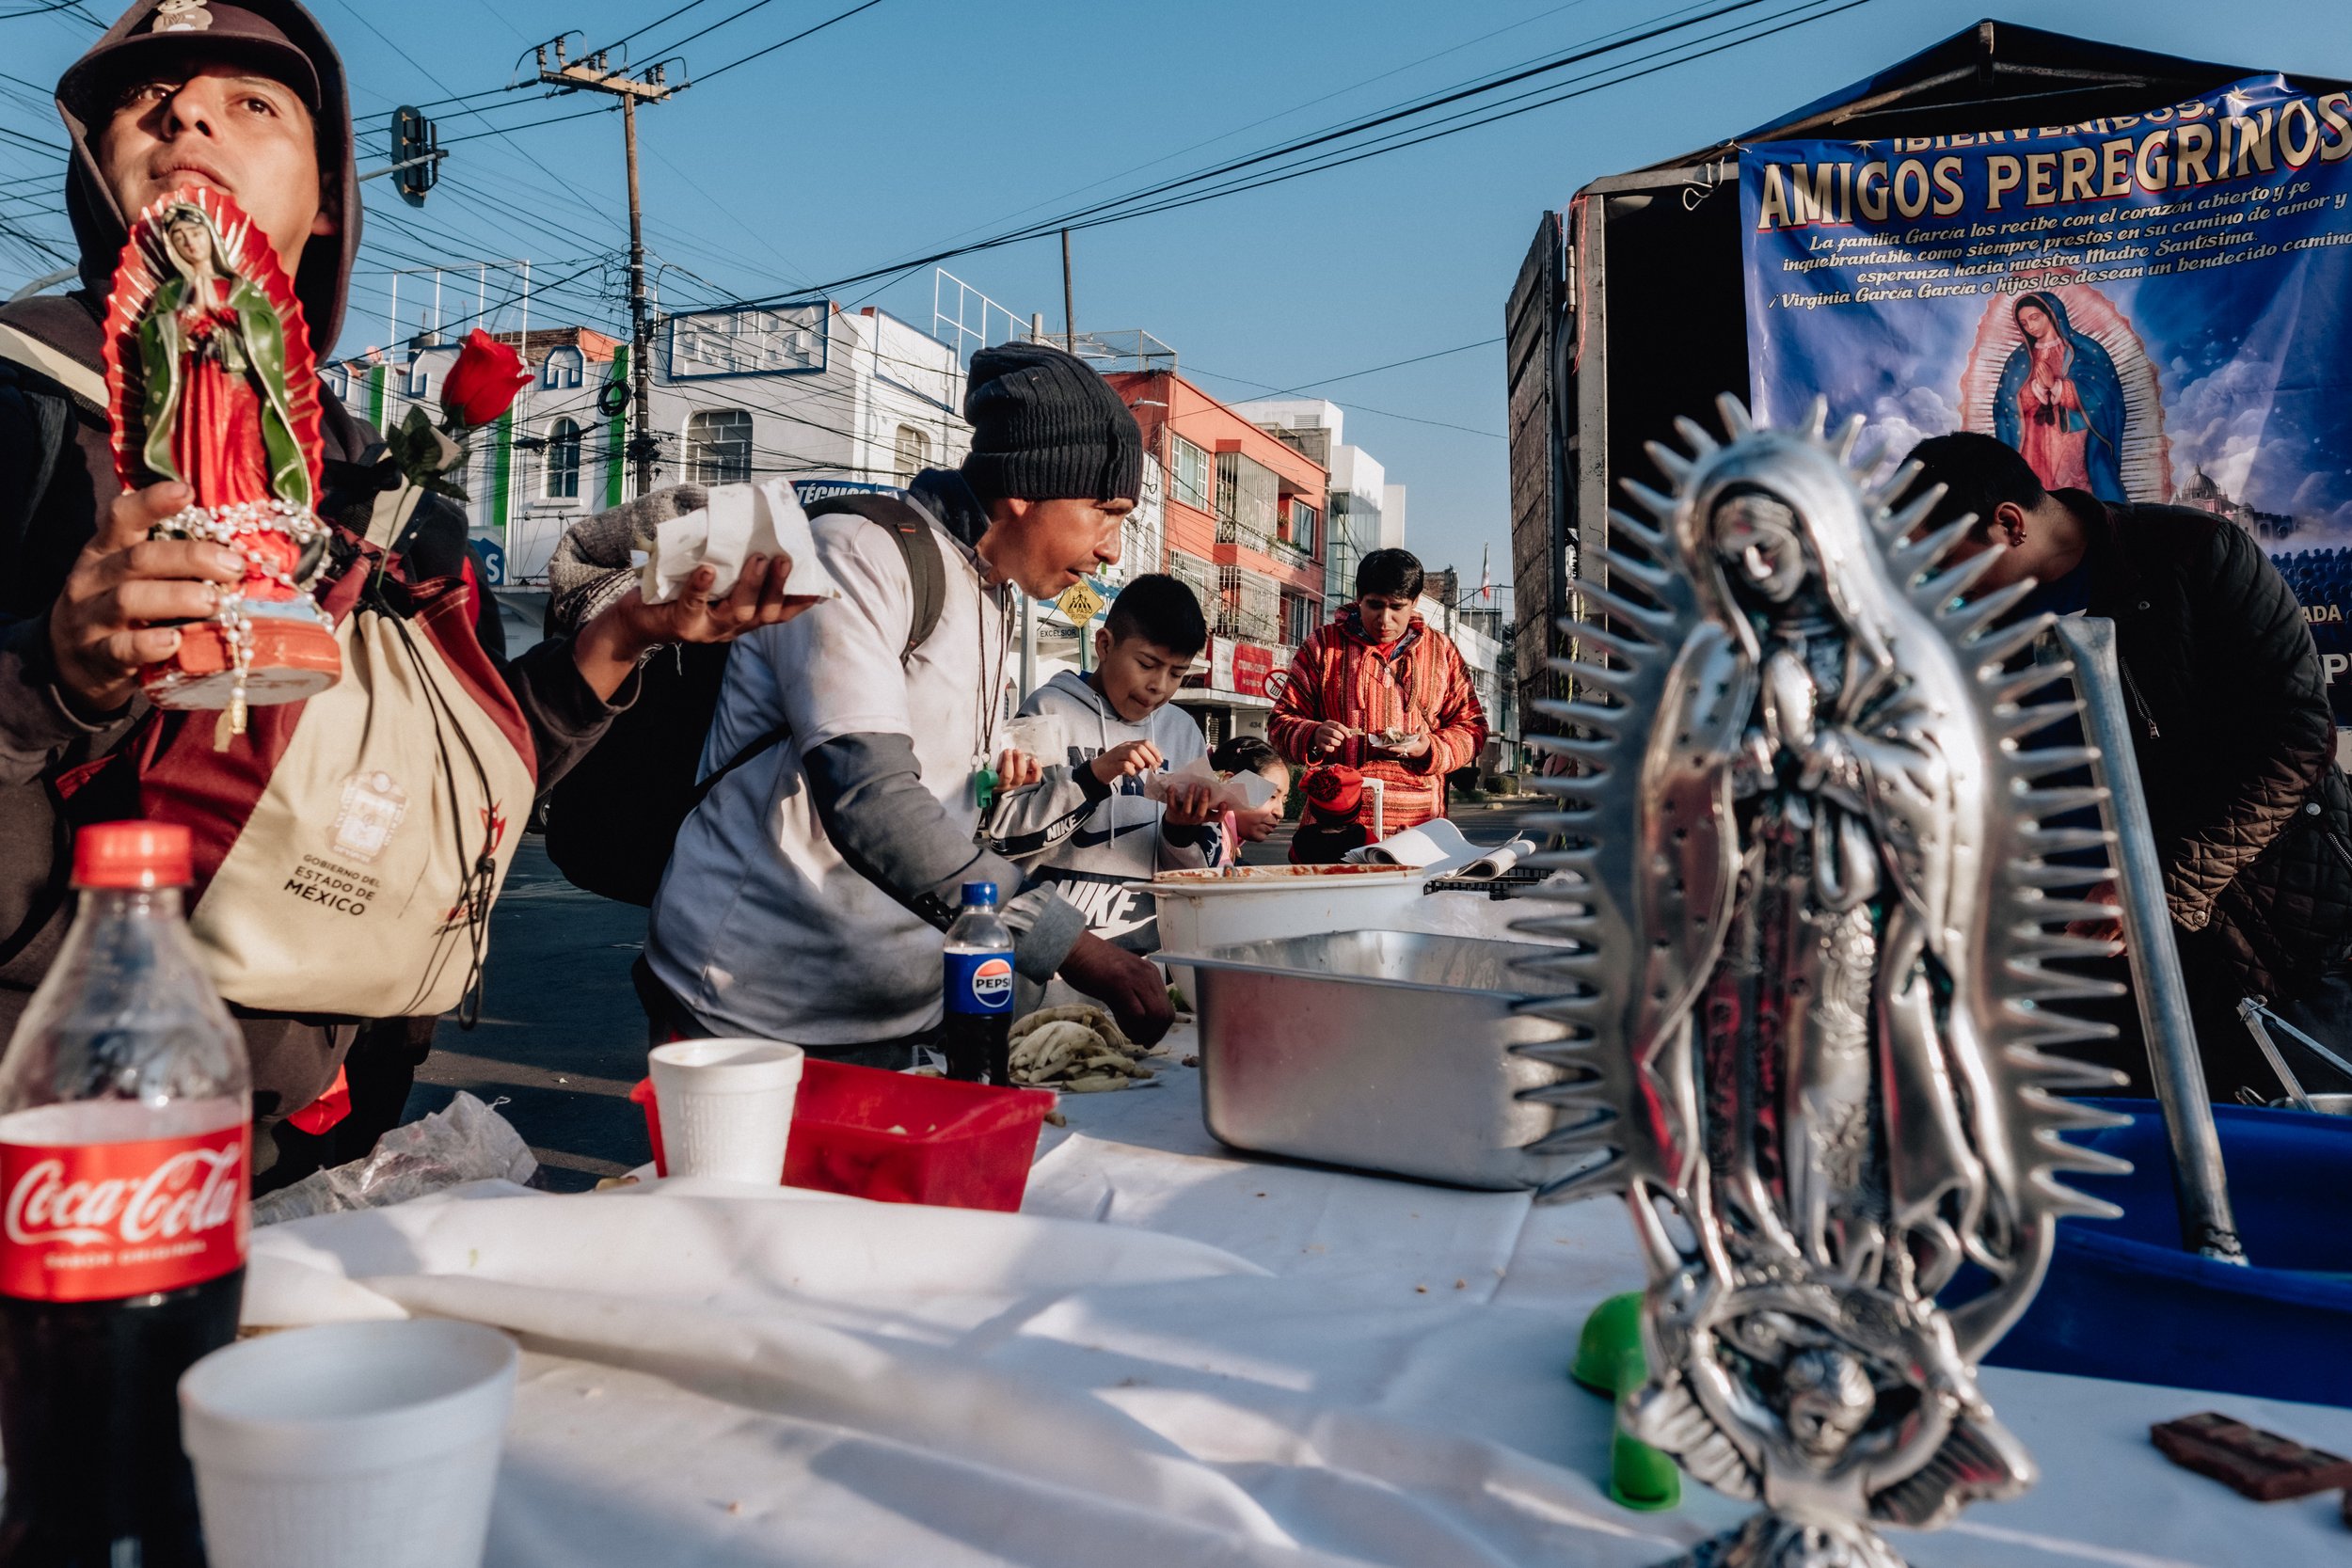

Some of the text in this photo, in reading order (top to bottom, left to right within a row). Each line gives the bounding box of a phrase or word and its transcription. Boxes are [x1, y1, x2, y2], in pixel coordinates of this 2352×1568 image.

[1757, 156, 1964, 230] AMIGOS
[1986, 92, 2352, 211] PEREGRINOS
[1809, 235, 1834, 251] La
[1836, 232, 1900, 252] familia
[1905, 226, 1965, 245] García
[1970, 223, 1995, 238] los
[2000, 216, 2058, 234] recibe
[2062, 214, 2094, 228] con
[2099, 208, 2117, 224] el
[2198, 186, 2269, 210] abierto
[2273, 186, 2284, 202] y
[2287, 182, 2311, 200] fe
[1917, 247, 1963, 261] como
[1966, 241, 2040, 258] siempre
[2042, 230, 2113, 252] prestos
[2116, 228, 2139, 240] en
[2144, 225, 2167, 237] su
[2171, 213, 2244, 233] camino
[2248, 206, 2271, 222] de
[2276, 196, 2330, 216] amor
[2334, 193, 2348, 210] y
[1855, 285, 1914, 303] García
[1917, 282, 1977, 299] García
[1980, 284, 1992, 293] e
[1995, 276, 2040, 296] hijos
[2043, 271, 2070, 288] les
[2074, 266, 2144, 284] desean
[2148, 263, 2171, 277] un
[2177, 244, 2278, 273] bendecido
[1857, 266, 1950, 286] esperanza
[1953, 261, 2005, 278] hacia
[2010, 252, 2080, 272] nuestra
[2084, 240, 2150, 263] Madre
[1046, 814, 1078, 843] NIKE
[294, 865, 376, 901] ESTADO DE
[303, 854, 380, 888] GOBIERNO DEL
[284, 879, 365, 916] MÉXICO
[1057, 879, 1140, 927] NIKE
[976, 977, 1010, 989] PEPSI
